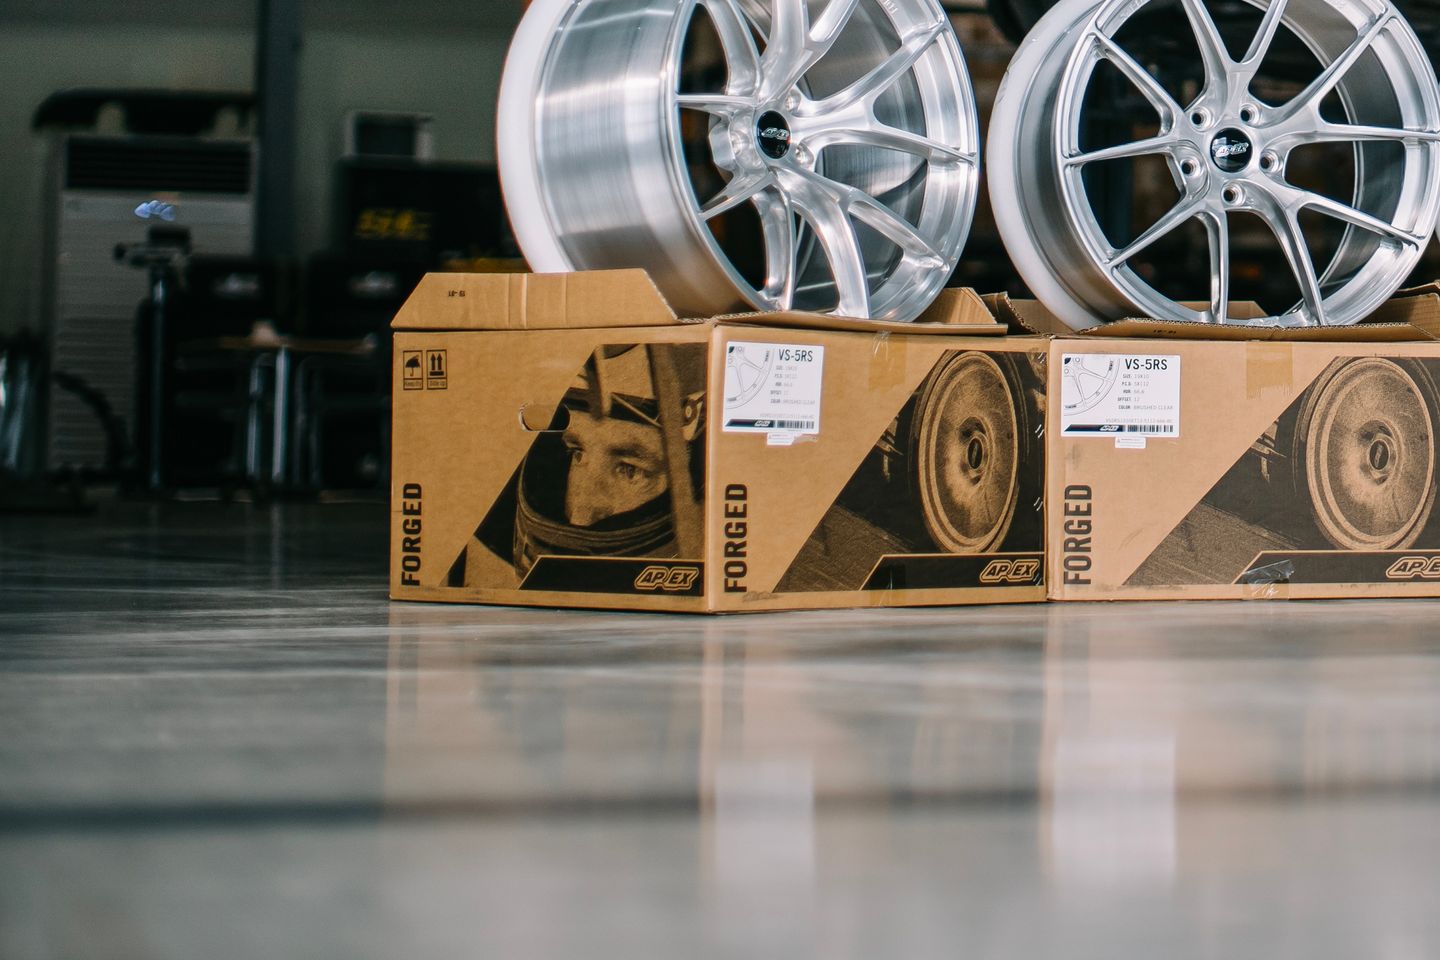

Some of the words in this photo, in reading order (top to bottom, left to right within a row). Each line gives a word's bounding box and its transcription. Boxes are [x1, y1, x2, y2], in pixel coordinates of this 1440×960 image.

[779, 348, 813, 362] VS-5RS
[1124, 358, 1168, 370] VS-5RS
[401, 482, 422, 586] FORGED
[724, 483, 748, 594] FORGED
[1063, 484, 1092, 585] FORGED
[638, 569, 695, 588] APEX
[983, 562, 1037, 579] APEX
